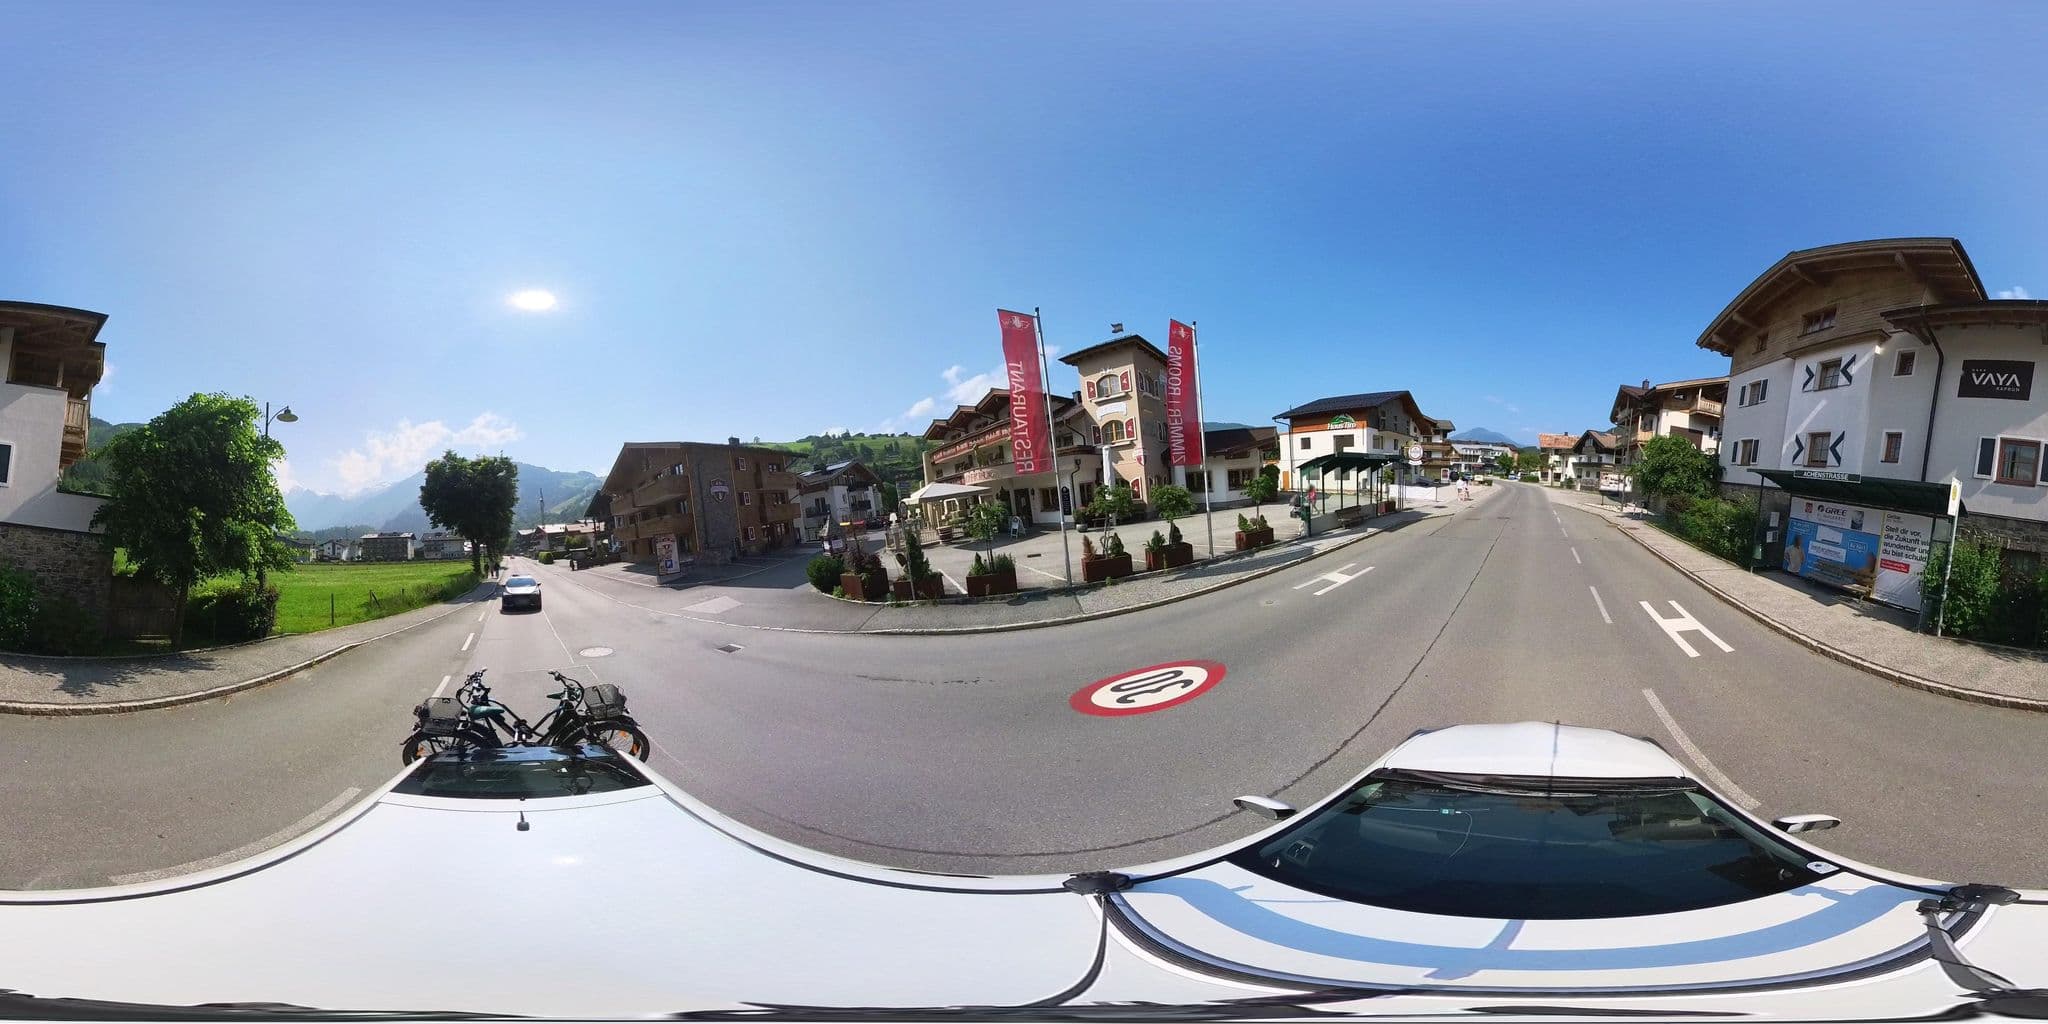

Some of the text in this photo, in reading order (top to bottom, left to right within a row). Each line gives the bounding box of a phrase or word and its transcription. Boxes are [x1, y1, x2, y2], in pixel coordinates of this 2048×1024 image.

[1971, 372, 2021, 387] VAYA
[1803, 471, 1849, 481] ACHENSTRASSE
[1885, 525, 1899, 533] Stell
[1894, 534, 1920, 545] Zukunft
[1883, 541, 1917, 552] wunderbar
[1110, 670, 1194, 704] 30
